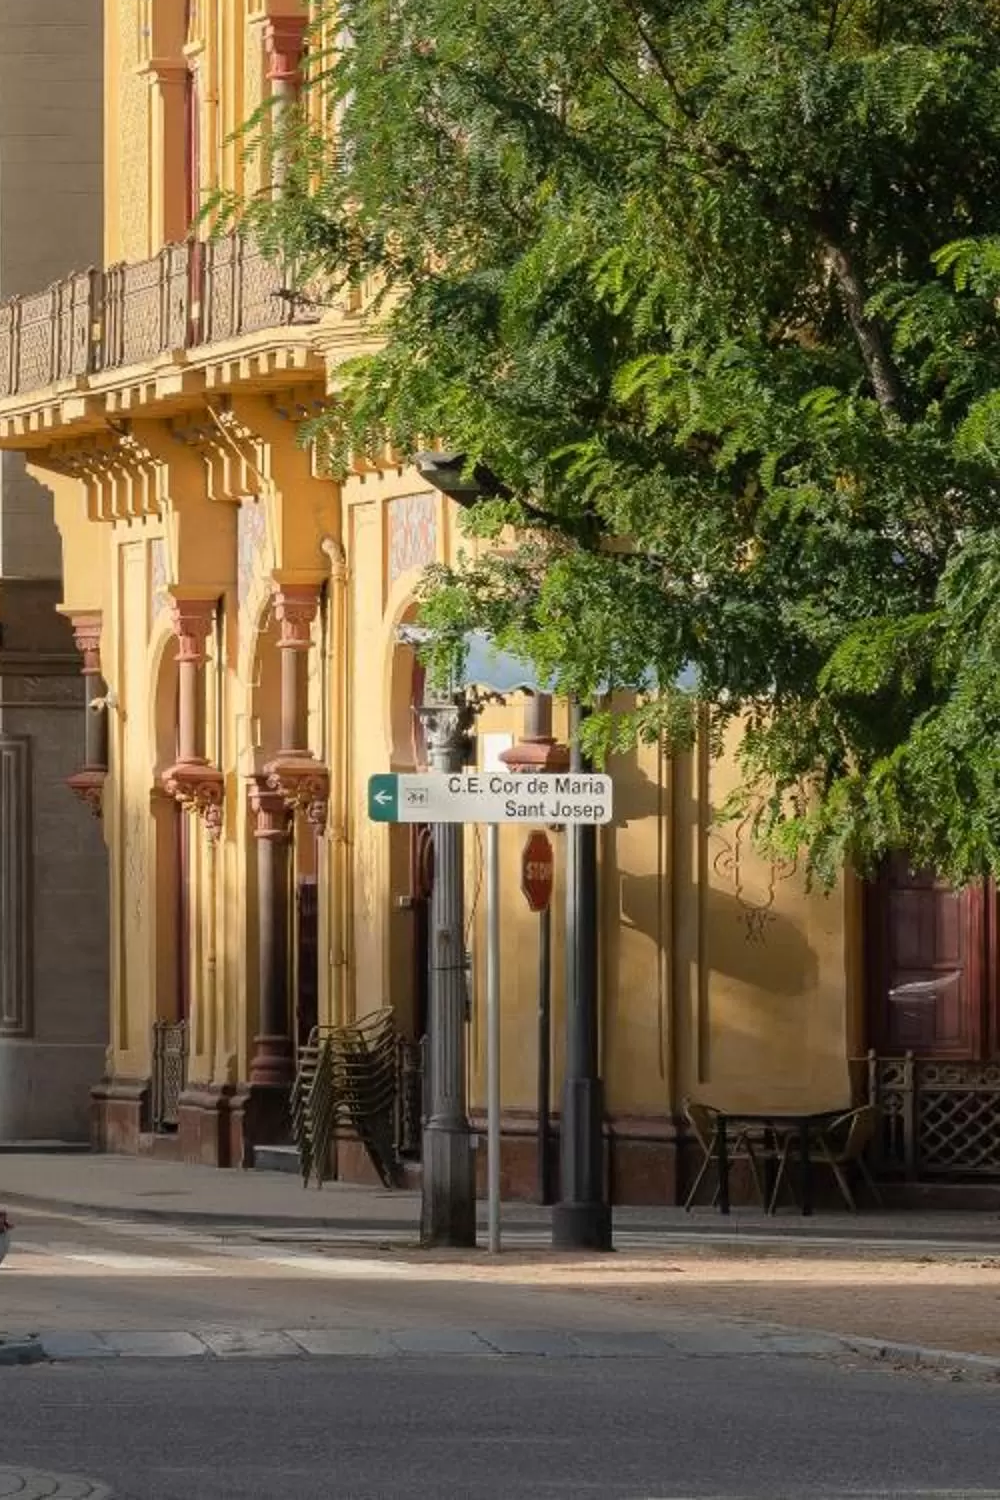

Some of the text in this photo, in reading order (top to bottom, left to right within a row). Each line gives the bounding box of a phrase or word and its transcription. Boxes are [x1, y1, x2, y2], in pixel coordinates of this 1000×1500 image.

[448, 777, 605, 794] C.E. Cor de Maria
[505, 800, 605, 821] Sant Josep
